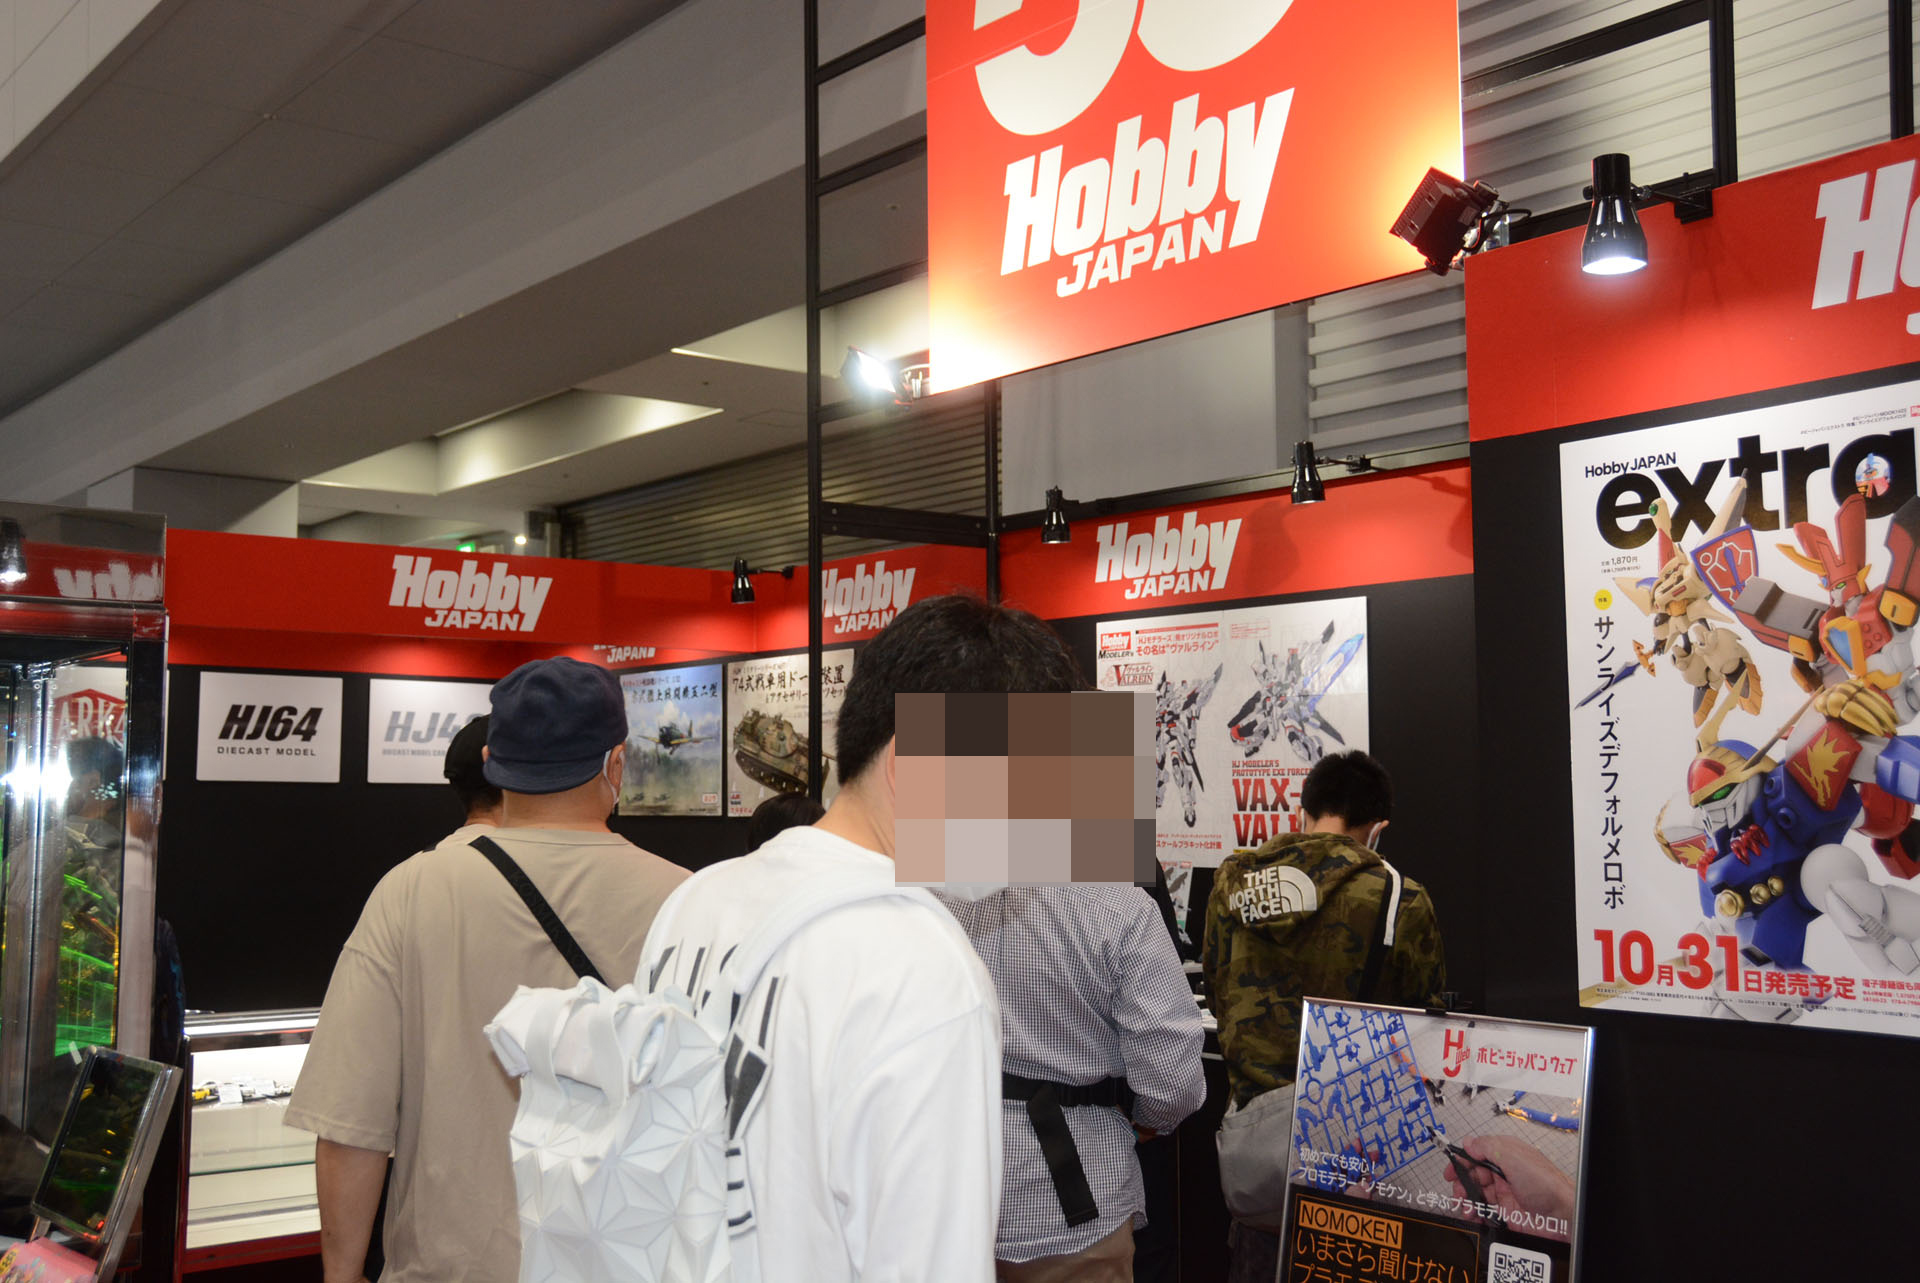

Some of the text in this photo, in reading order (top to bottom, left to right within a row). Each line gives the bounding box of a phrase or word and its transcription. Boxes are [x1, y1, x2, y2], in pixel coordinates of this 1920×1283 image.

[1001, 87, 1295, 276] Hobby
[1056, 209, 1226, 297] JAPAN
[1585, 452, 1677, 478] Hobby JAPAN
[1596, 427, 1918, 549] extra
[1095, 511, 1242, 590] Hobby
[1611, 556, 1638, 566] 1,870円
[389, 555, 553, 632] Hobby
[822, 560, 916, 618] Hobby
[1125, 570, 1210, 600] JAPAN
[425, 609, 519, 631] JAPAN
[834, 610, 894, 633] JAPAN
[607, 646, 649, 663] JAPAN
[732, 664, 845, 693] 74式戦車用ドー装置
[218, 704, 323, 742] HJ64
[384, 711, 482, 743] HJ4
[217, 746, 317, 756] DIECAST MODEL
[1594, 616, 1626, 910] サンライズデフォルメロボ
[1232, 768, 1270, 777] PROTOTYPE
[1232, 778, 1306, 812] VAX-
[1243, 866, 1278, 888] THE
[1229, 882, 1280, 911] NORTH
[1240, 898, 1282, 924] FACE
[1594, 929, 1856, 1000] 10月31日発売予定
[1300, 1204, 1399, 1245] NOMOKEN
[1296, 1229, 1469, 1283] いまさら聞けない
